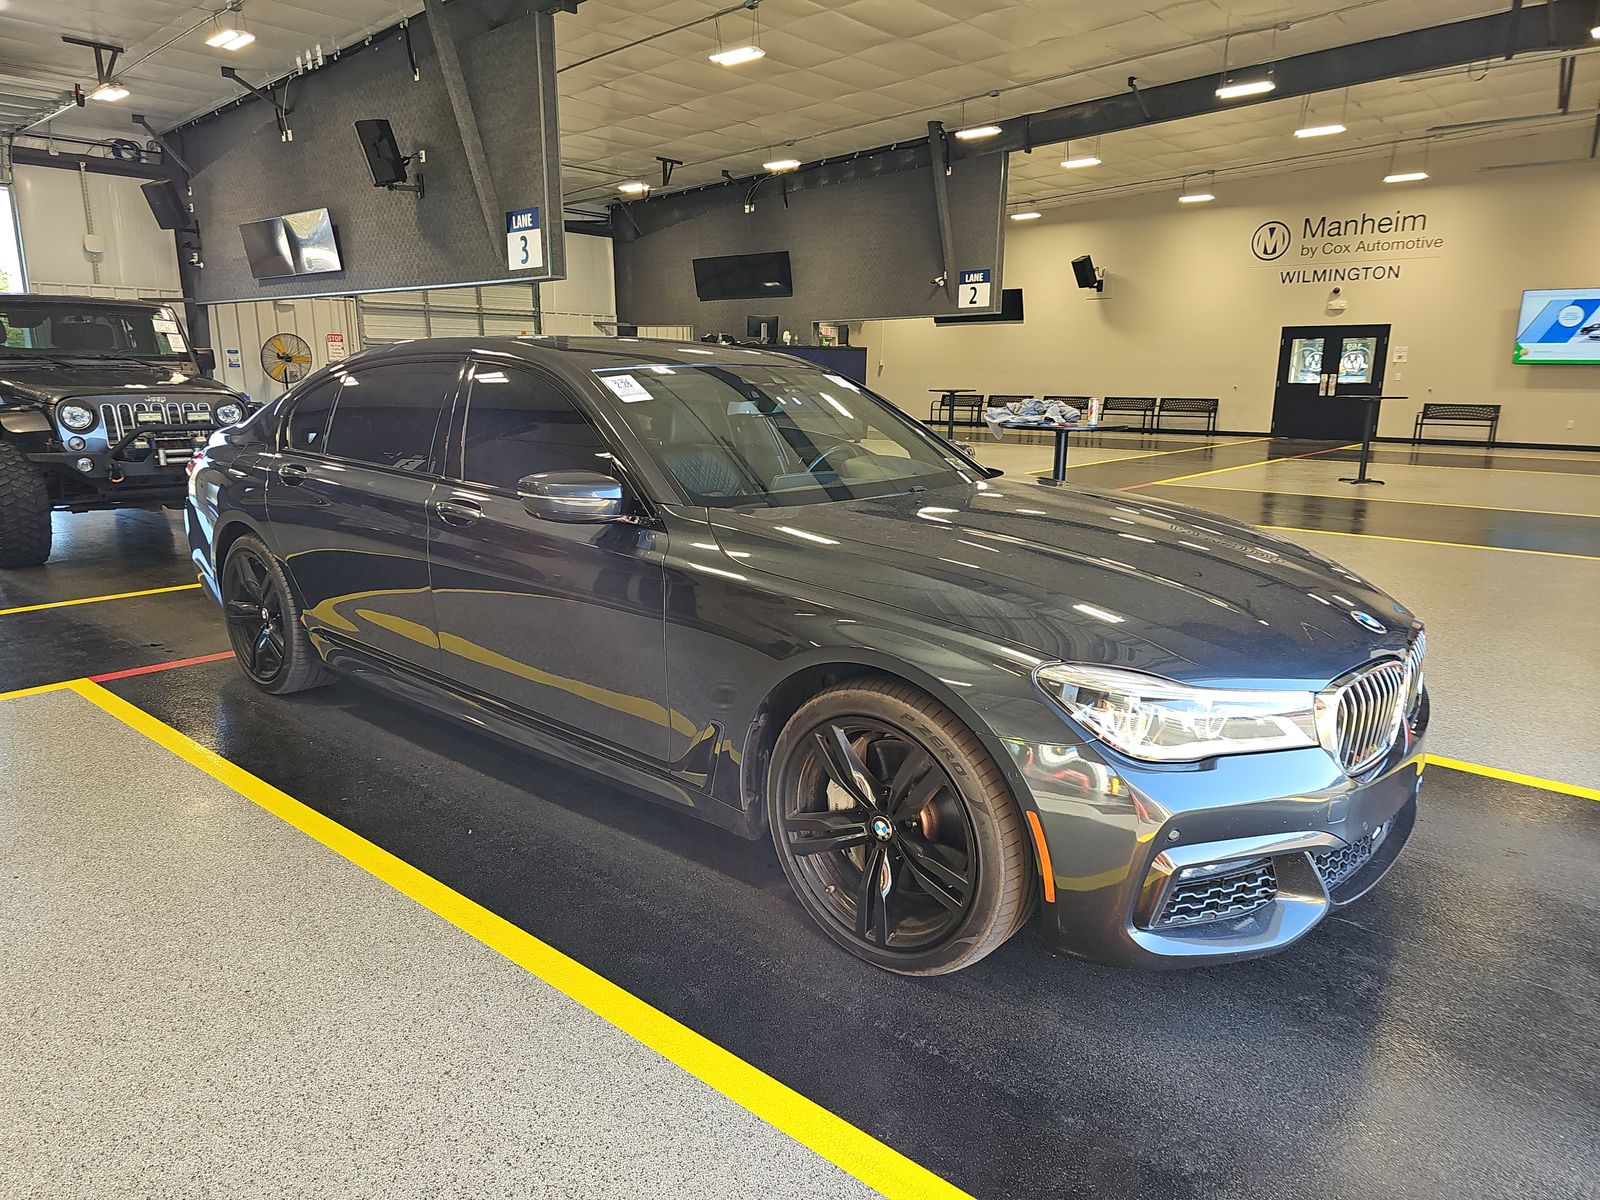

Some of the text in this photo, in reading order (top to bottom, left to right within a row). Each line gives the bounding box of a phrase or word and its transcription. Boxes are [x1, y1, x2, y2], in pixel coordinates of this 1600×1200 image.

[512, 213, 533, 229] LANE
[1303, 210, 1427, 239] Manheim
[519, 235, 529, 264] 3
[1300, 236, 1444, 258] by Cox Automotive
[965, 272, 984, 283] LANE
[1280, 265, 1401, 284] WILMINGTON
[969, 286, 977, 305] 2
[144, 395, 167, 403] Jeep
[915, 724, 968, 776] ZERO
